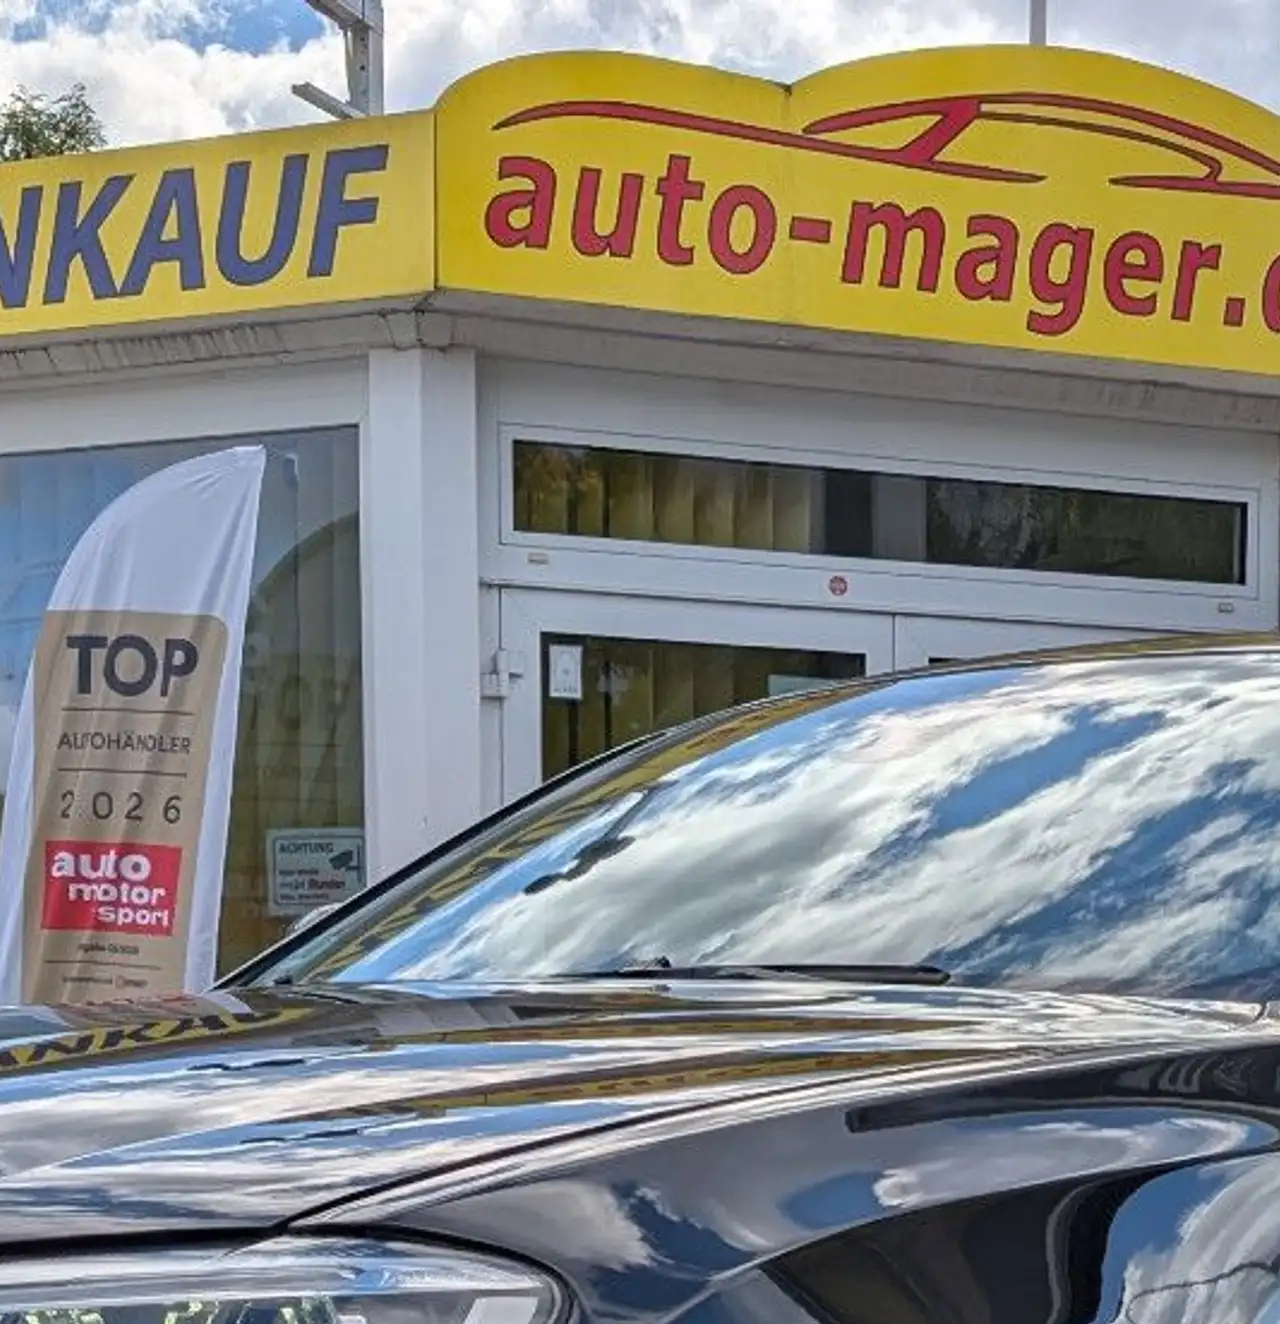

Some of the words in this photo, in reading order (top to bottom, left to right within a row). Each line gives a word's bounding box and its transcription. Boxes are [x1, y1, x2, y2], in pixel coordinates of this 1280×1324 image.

[66, 634, 199, 697] TOP
[57, 731, 191, 755] AUTOHÄNDLER
[60, 789, 183, 824] 2026
[51, 848, 151, 882] auto
[68, 882, 166, 906] motor
[97, 905, 169, 928] sport
